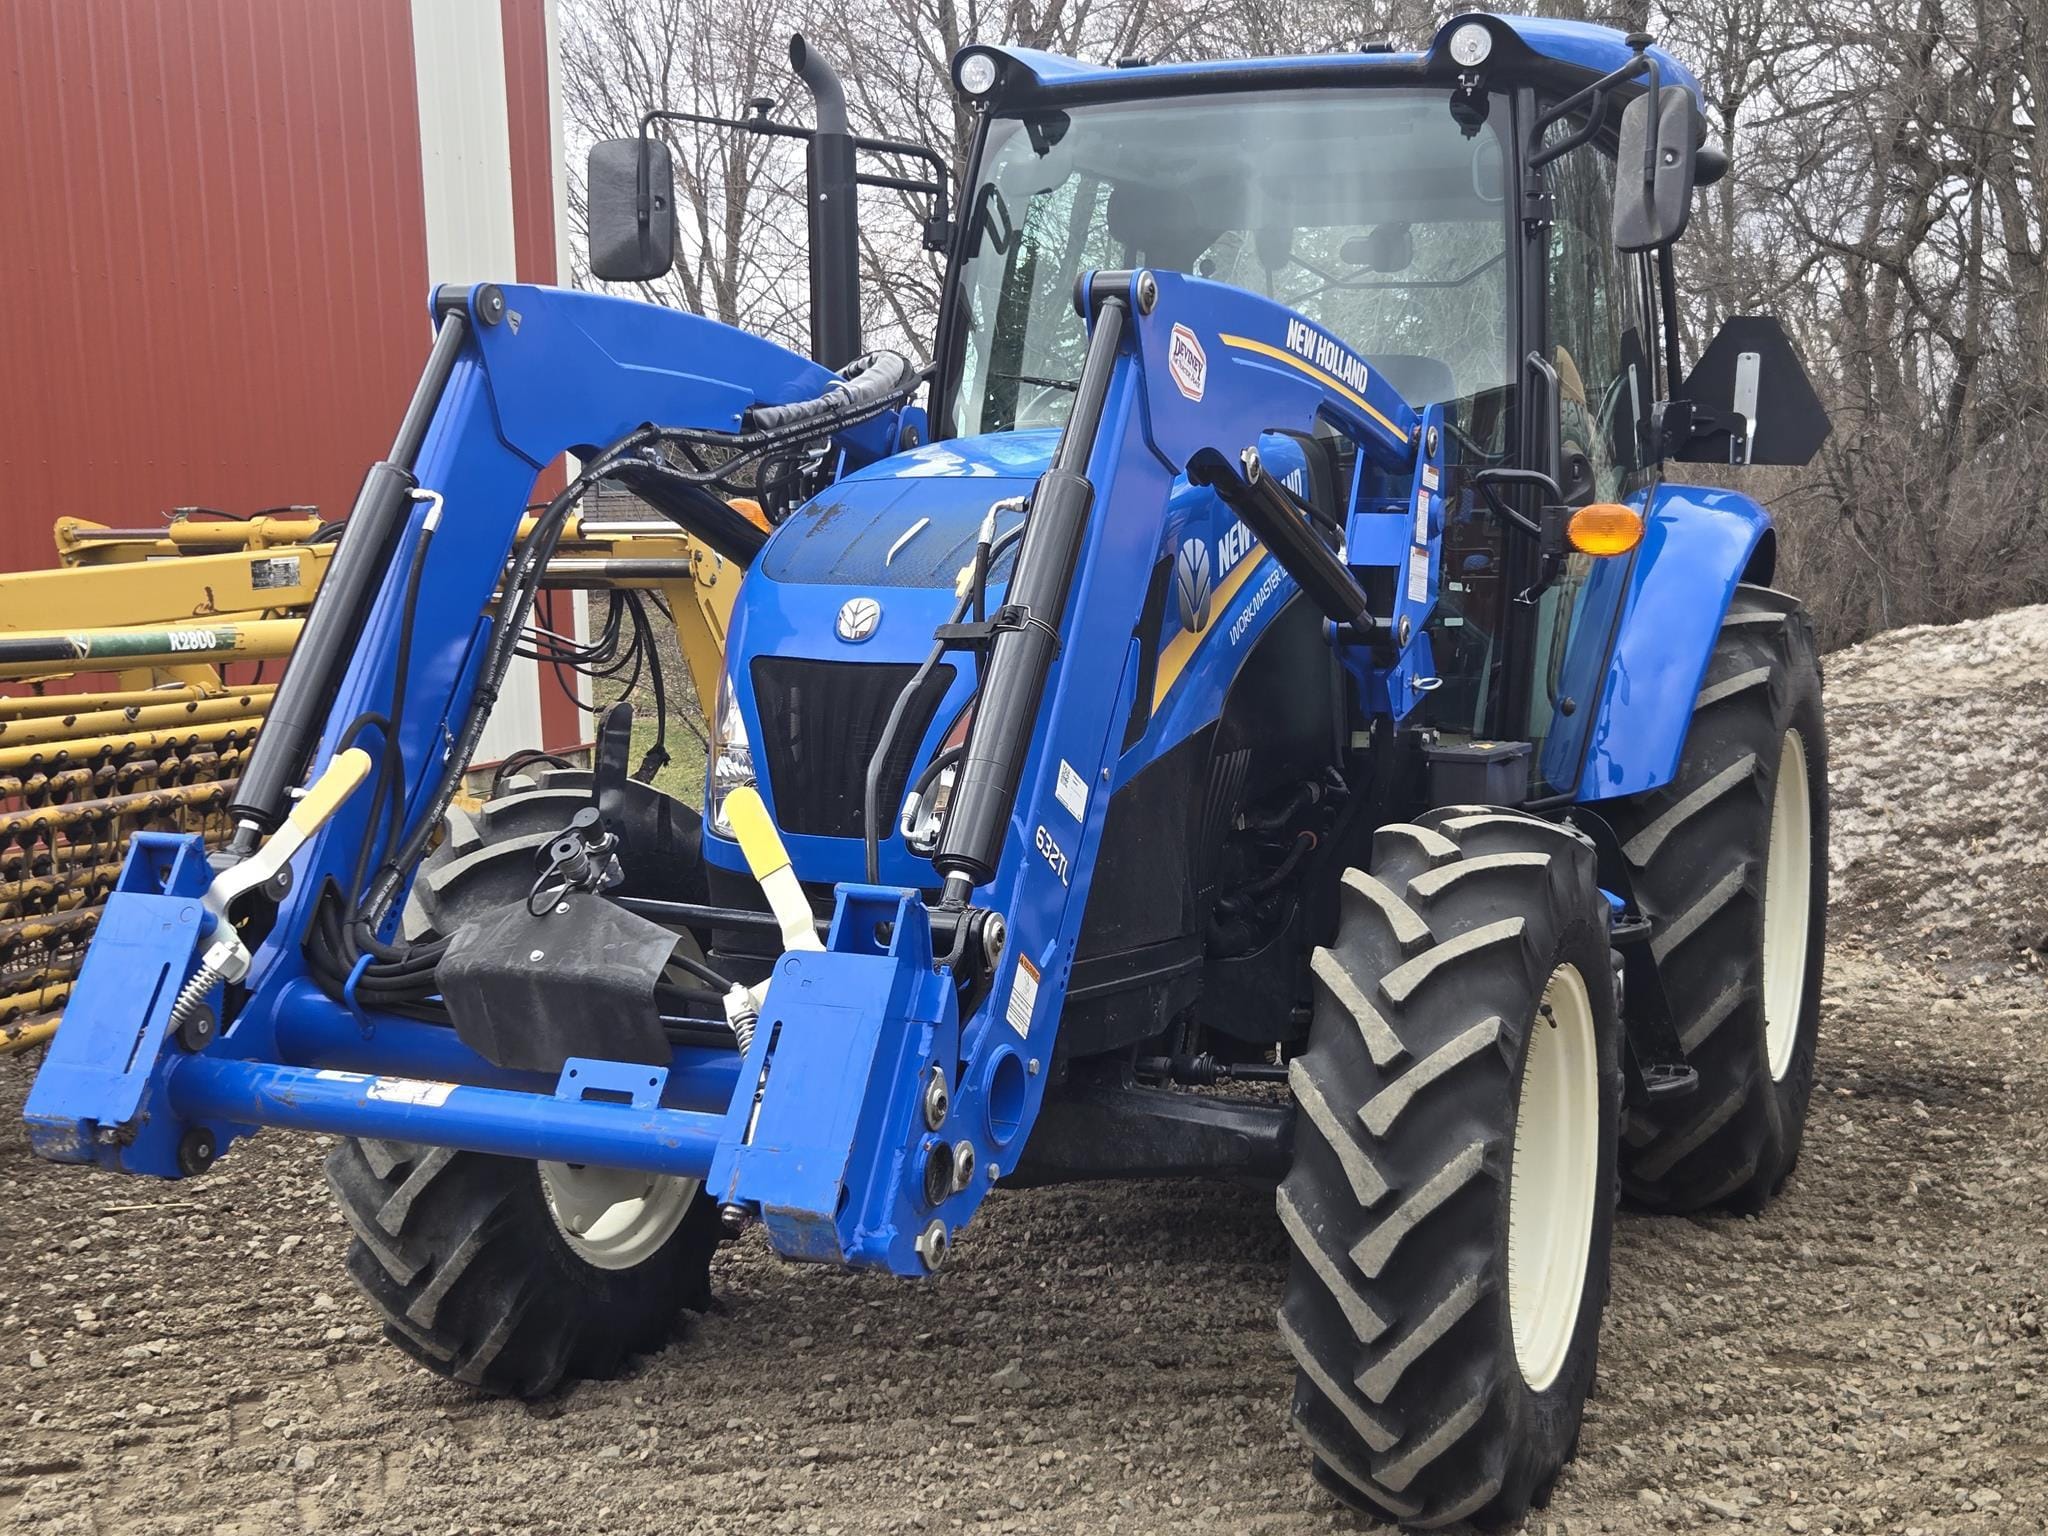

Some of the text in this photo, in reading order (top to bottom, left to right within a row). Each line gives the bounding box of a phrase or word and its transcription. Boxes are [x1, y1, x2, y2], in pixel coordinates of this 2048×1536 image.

[1173, 336, 1204, 381] DEVINEY
[1286, 317, 1368, 394] NEW HOLLAND
[1218, 520, 1250, 578] NEW
[1229, 569, 1282, 646] WORKMASTER
[168, 631, 216, 651] R2800
[1036, 825, 1068, 887] 632TL
